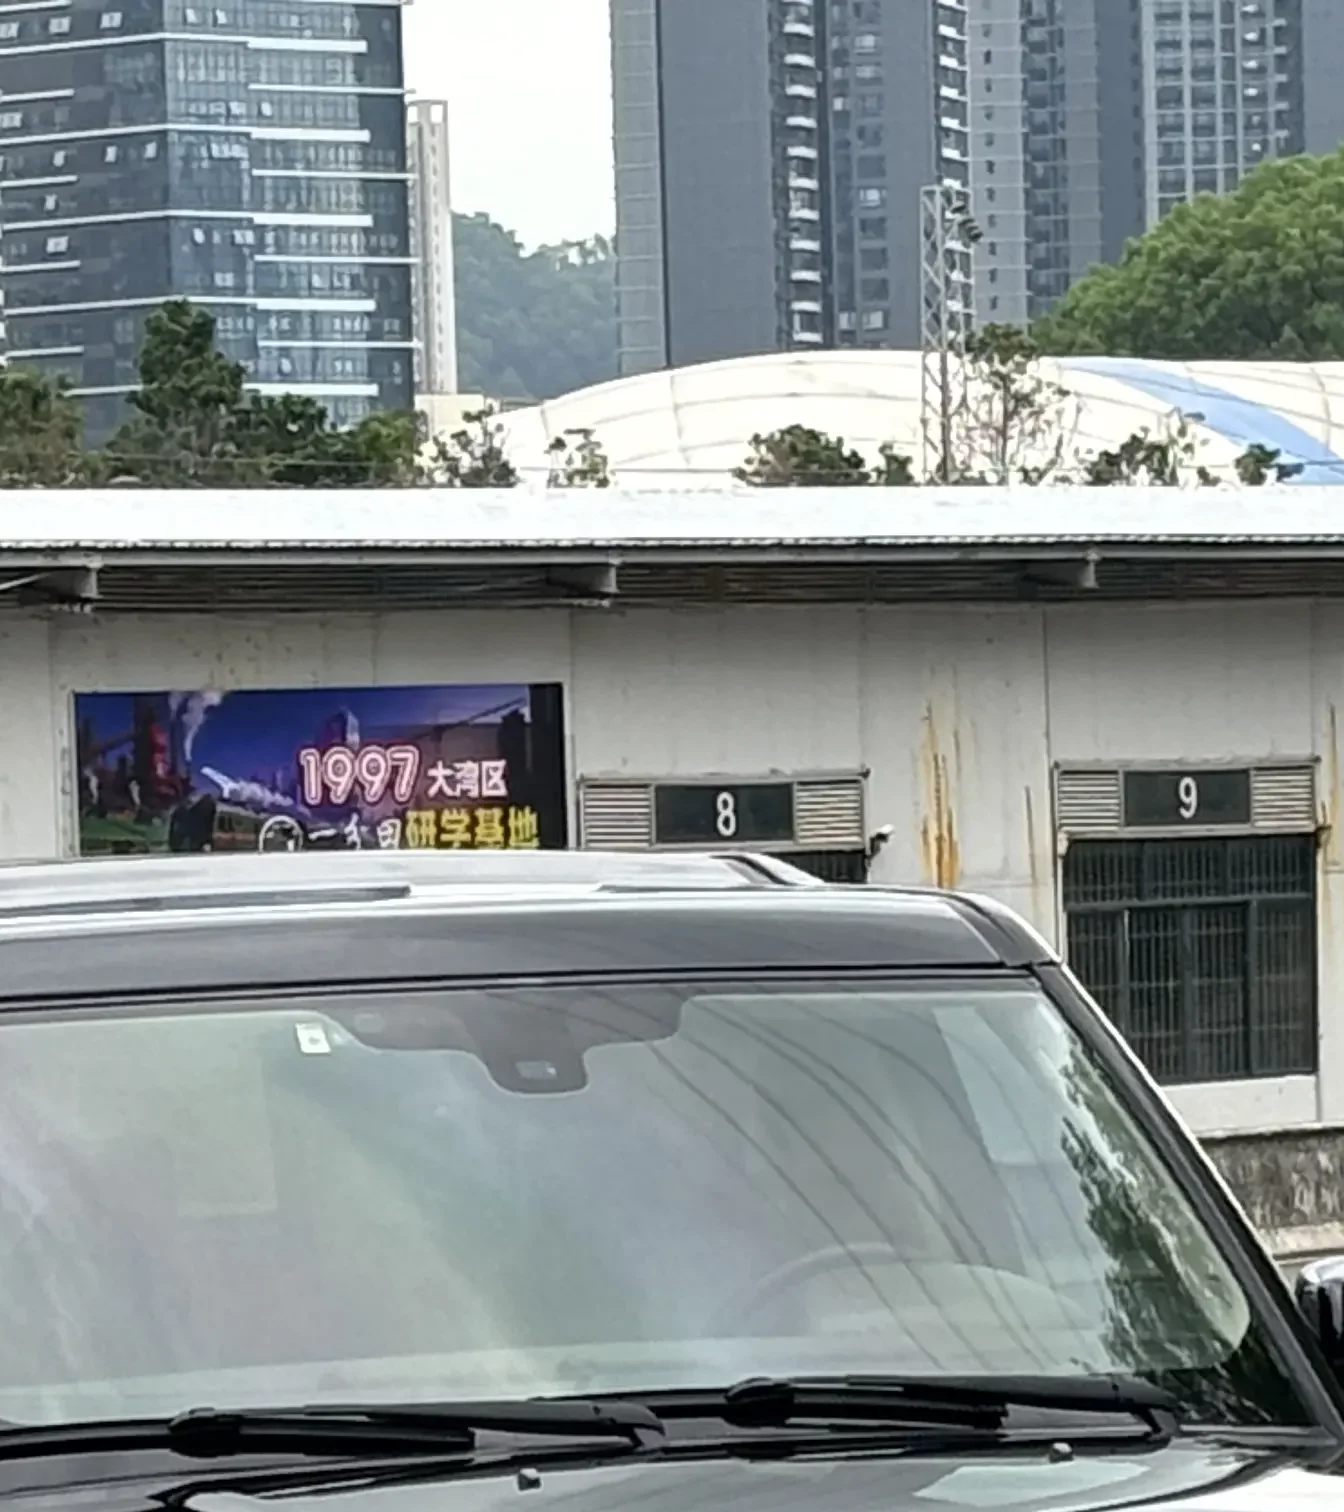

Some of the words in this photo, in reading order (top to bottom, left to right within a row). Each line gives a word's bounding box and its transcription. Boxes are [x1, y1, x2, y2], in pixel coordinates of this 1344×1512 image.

[300, 745, 419, 805] 1997
[427, 759, 507, 798] 大湾区
[715, 792, 737, 836] 8
[1177, 776, 1198, 819] 9
